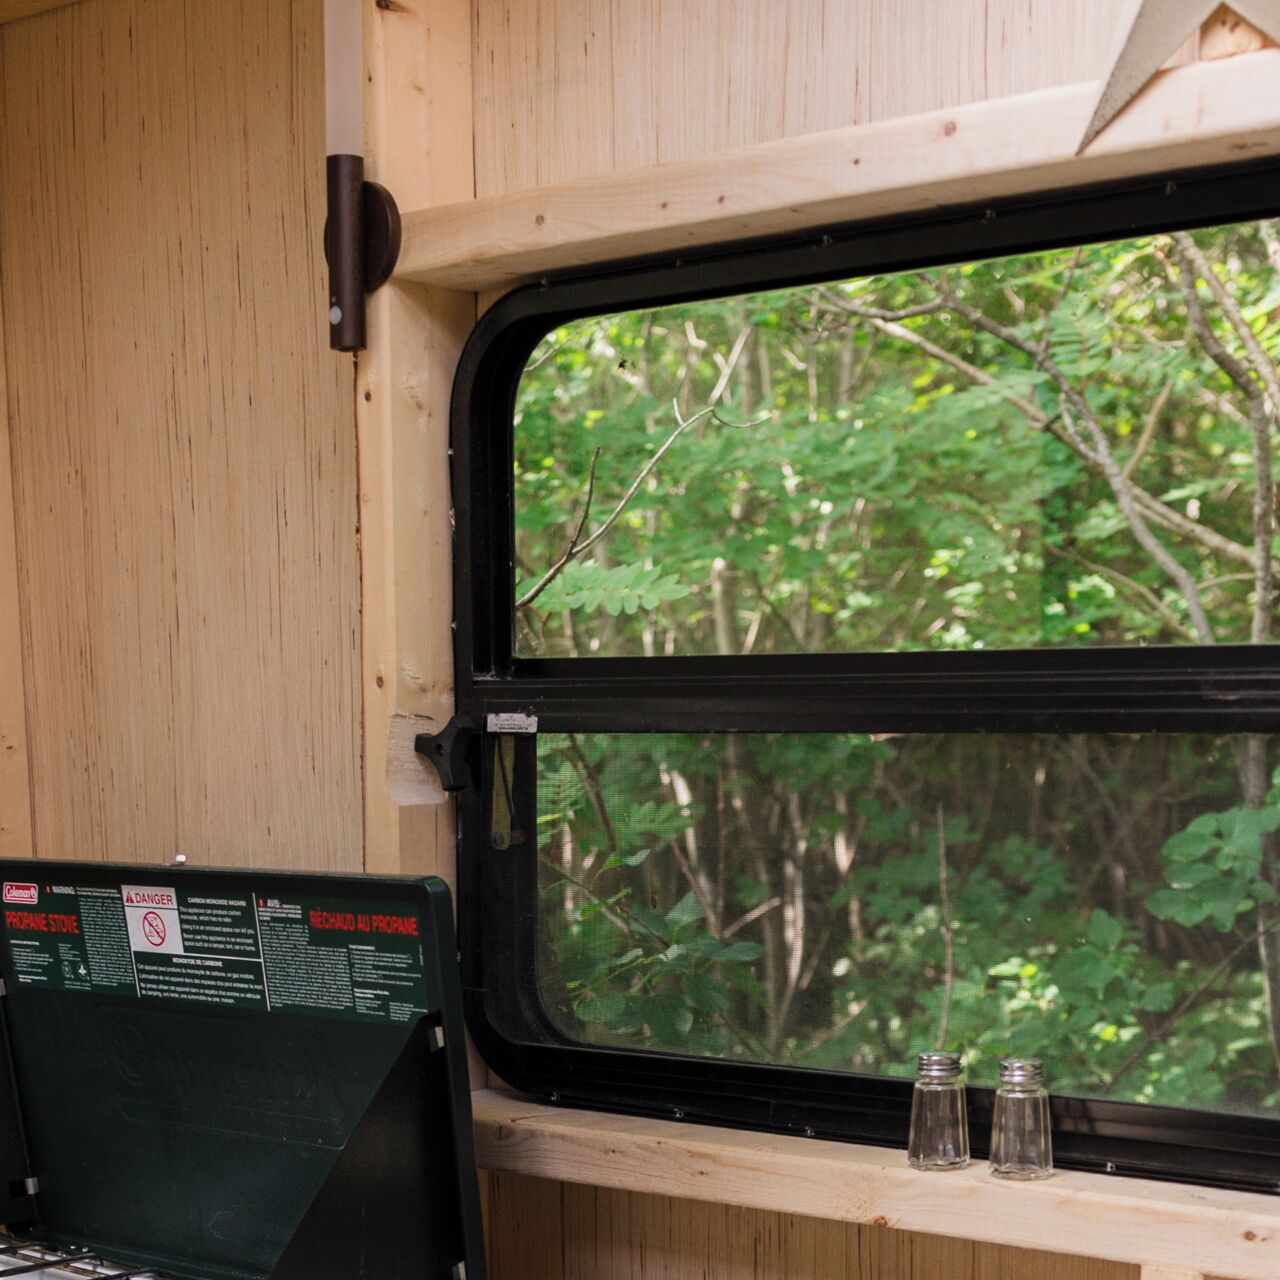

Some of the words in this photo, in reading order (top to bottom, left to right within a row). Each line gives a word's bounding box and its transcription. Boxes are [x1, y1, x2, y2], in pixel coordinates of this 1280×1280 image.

[134, 892, 173, 906] DANGER
[5, 911, 49, 931] PROPANE
[48, 913, 80, 934] STOVE
[309, 906, 355, 931] RÉCHAUD
[357, 914, 370, 933] AU
[372, 913, 419, 936] PROPANE
